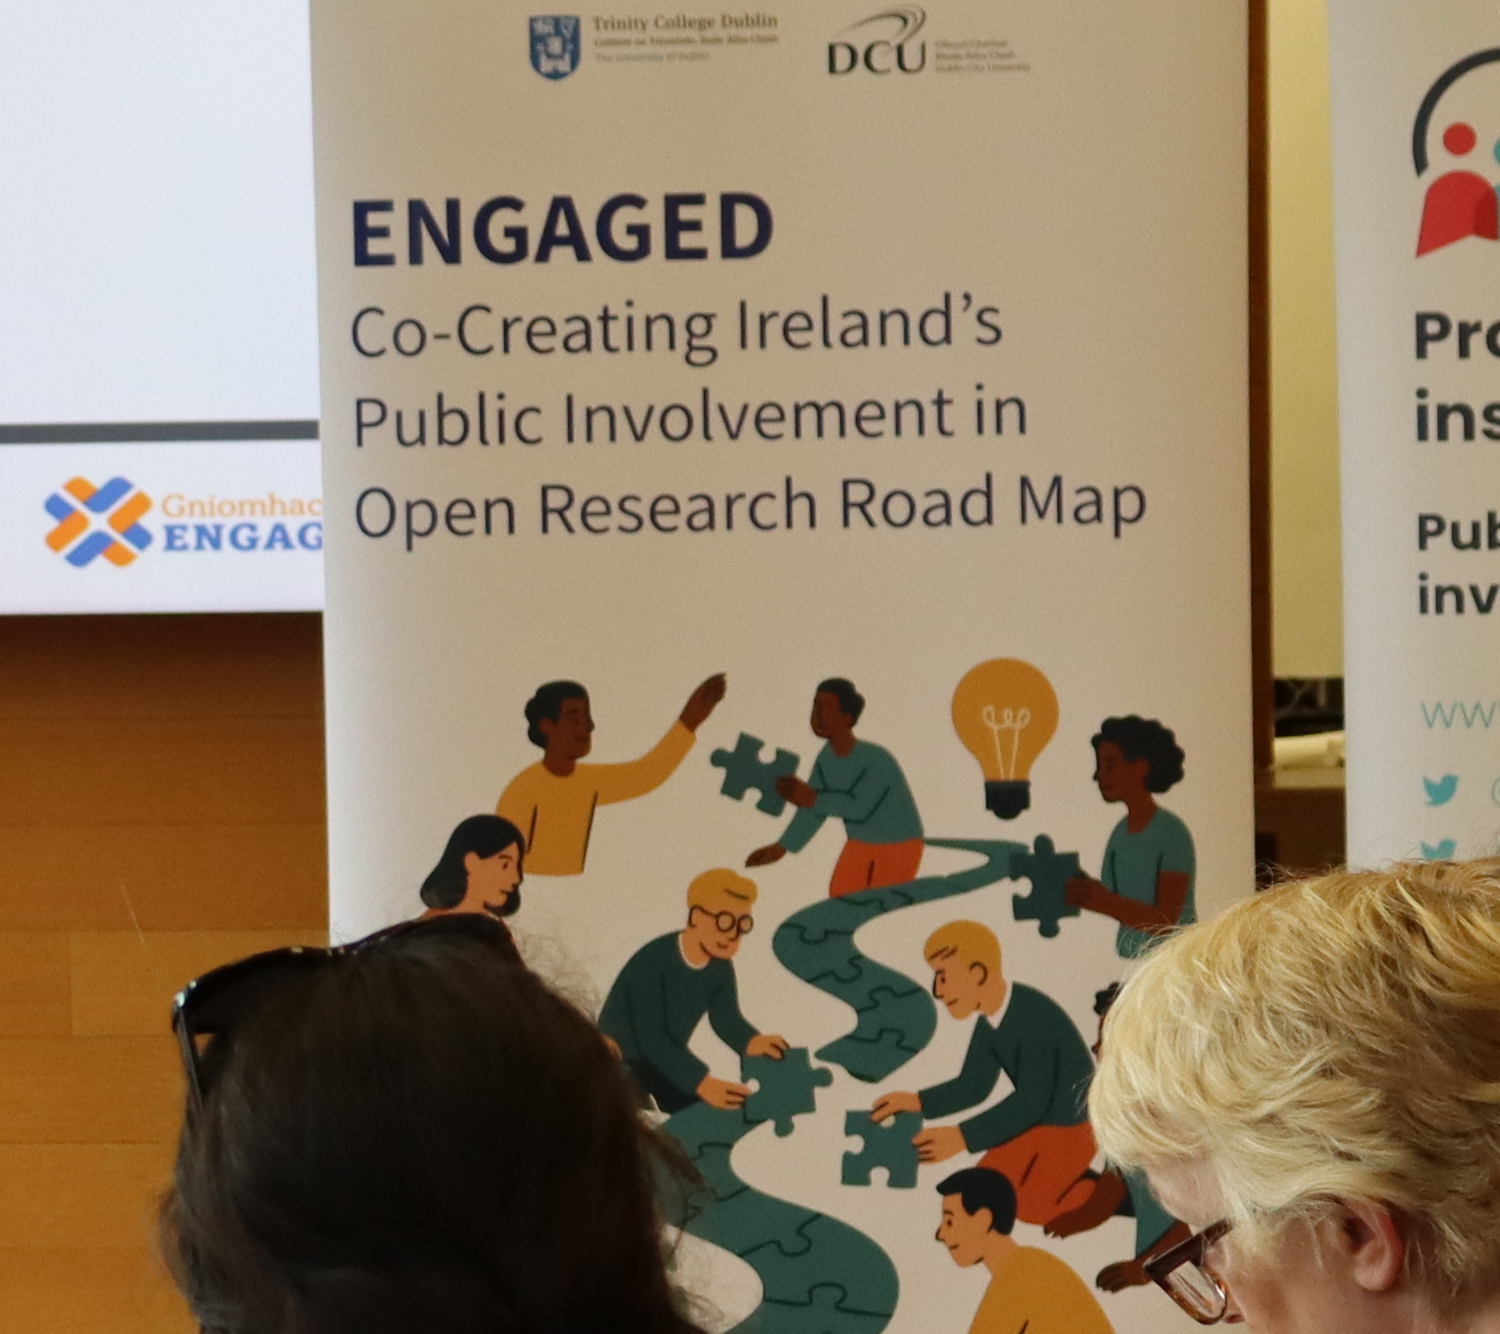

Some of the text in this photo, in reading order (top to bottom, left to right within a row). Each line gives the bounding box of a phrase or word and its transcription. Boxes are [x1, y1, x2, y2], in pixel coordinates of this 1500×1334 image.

[593, 12, 779, 33] Trinity College Dublin
[827, 38, 926, 75] DCU
[350, 191, 774, 268] ENGAGED
[350, 298, 719, 369] Co-Creating
[354, 383, 1029, 449] Public Involvement in
[161, 493, 323, 519] Gníomhac
[355, 472, 1148, 552] Open Research Road Map
[163, 522, 323, 553] ENGAG
